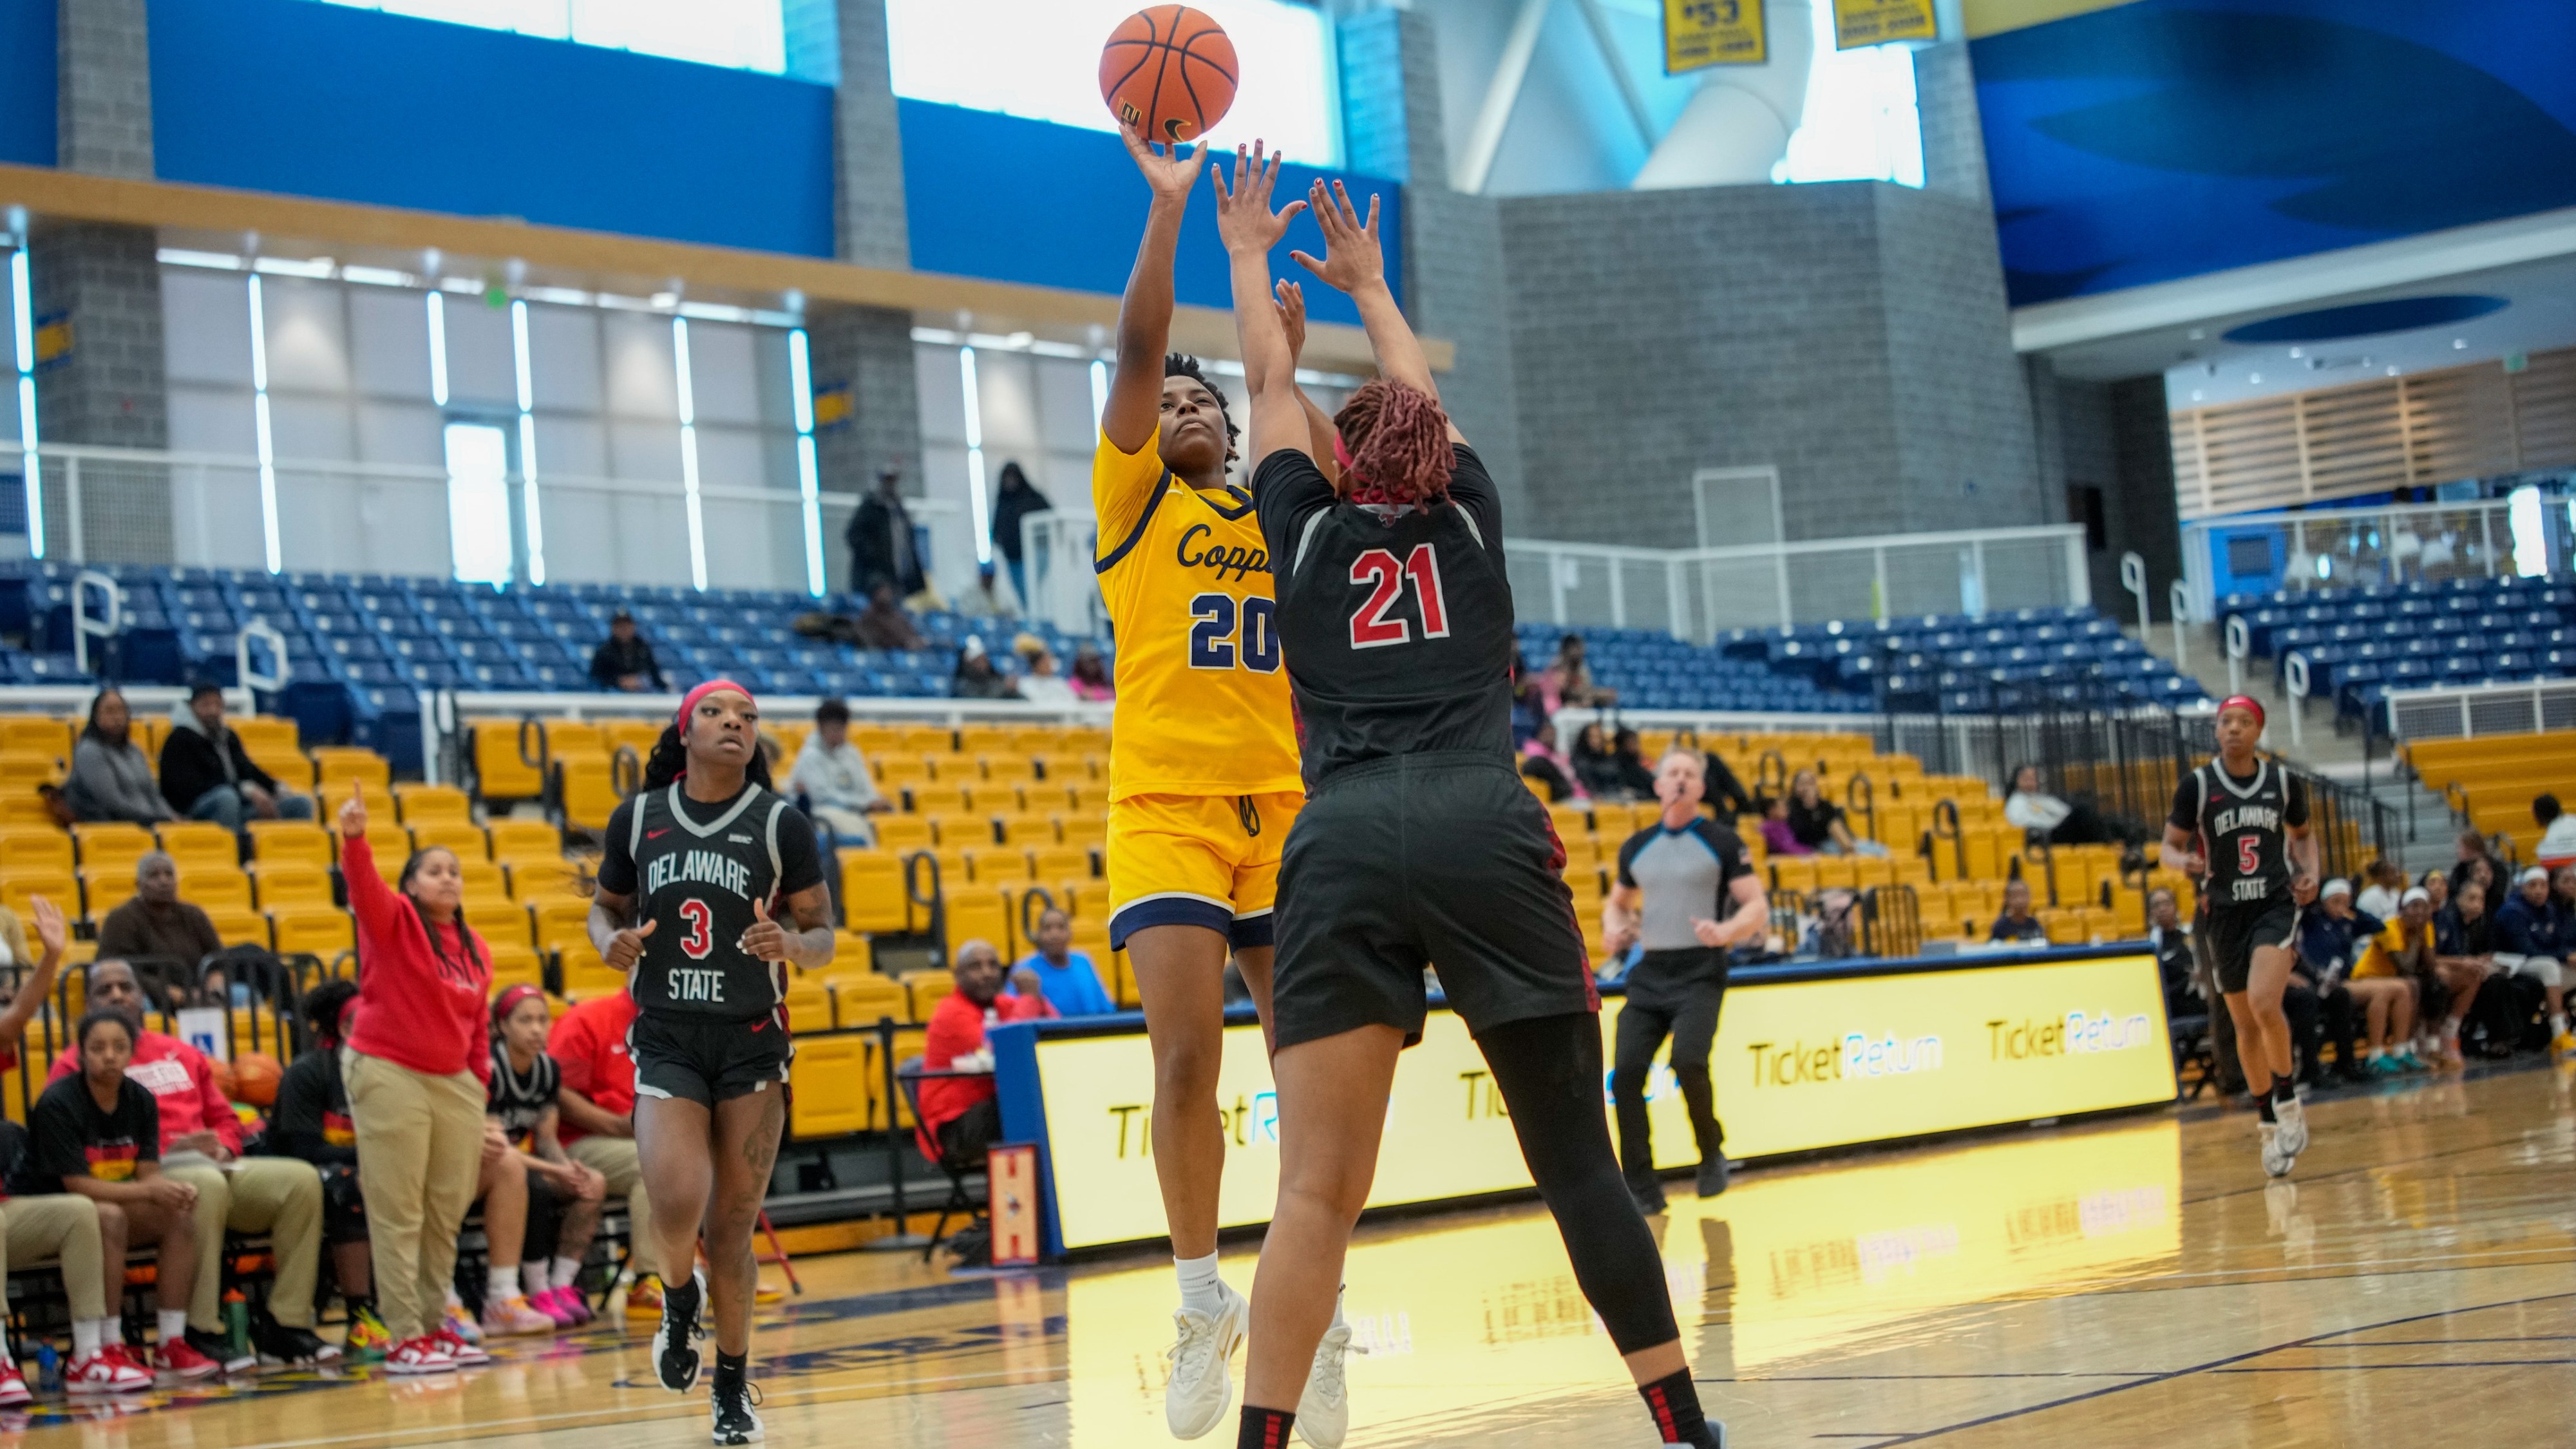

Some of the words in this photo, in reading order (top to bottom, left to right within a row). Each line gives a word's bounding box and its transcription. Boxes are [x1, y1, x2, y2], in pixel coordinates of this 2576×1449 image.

[1349, 542, 1450, 650] 21
[1188, 592, 1281, 674] 20
[2214, 806, 2278, 837] DELAWARE
[648, 849, 750, 900] DELAWARE
[2237, 834, 2261, 875] 5
[2232, 876, 2268, 901] STATE
[679, 898, 712, 960] 3
[668, 968, 725, 1002] STATE
[1748, 1034, 1940, 1087] TicketReturn
[1985, 1013, 2149, 1061] TicketReturn
